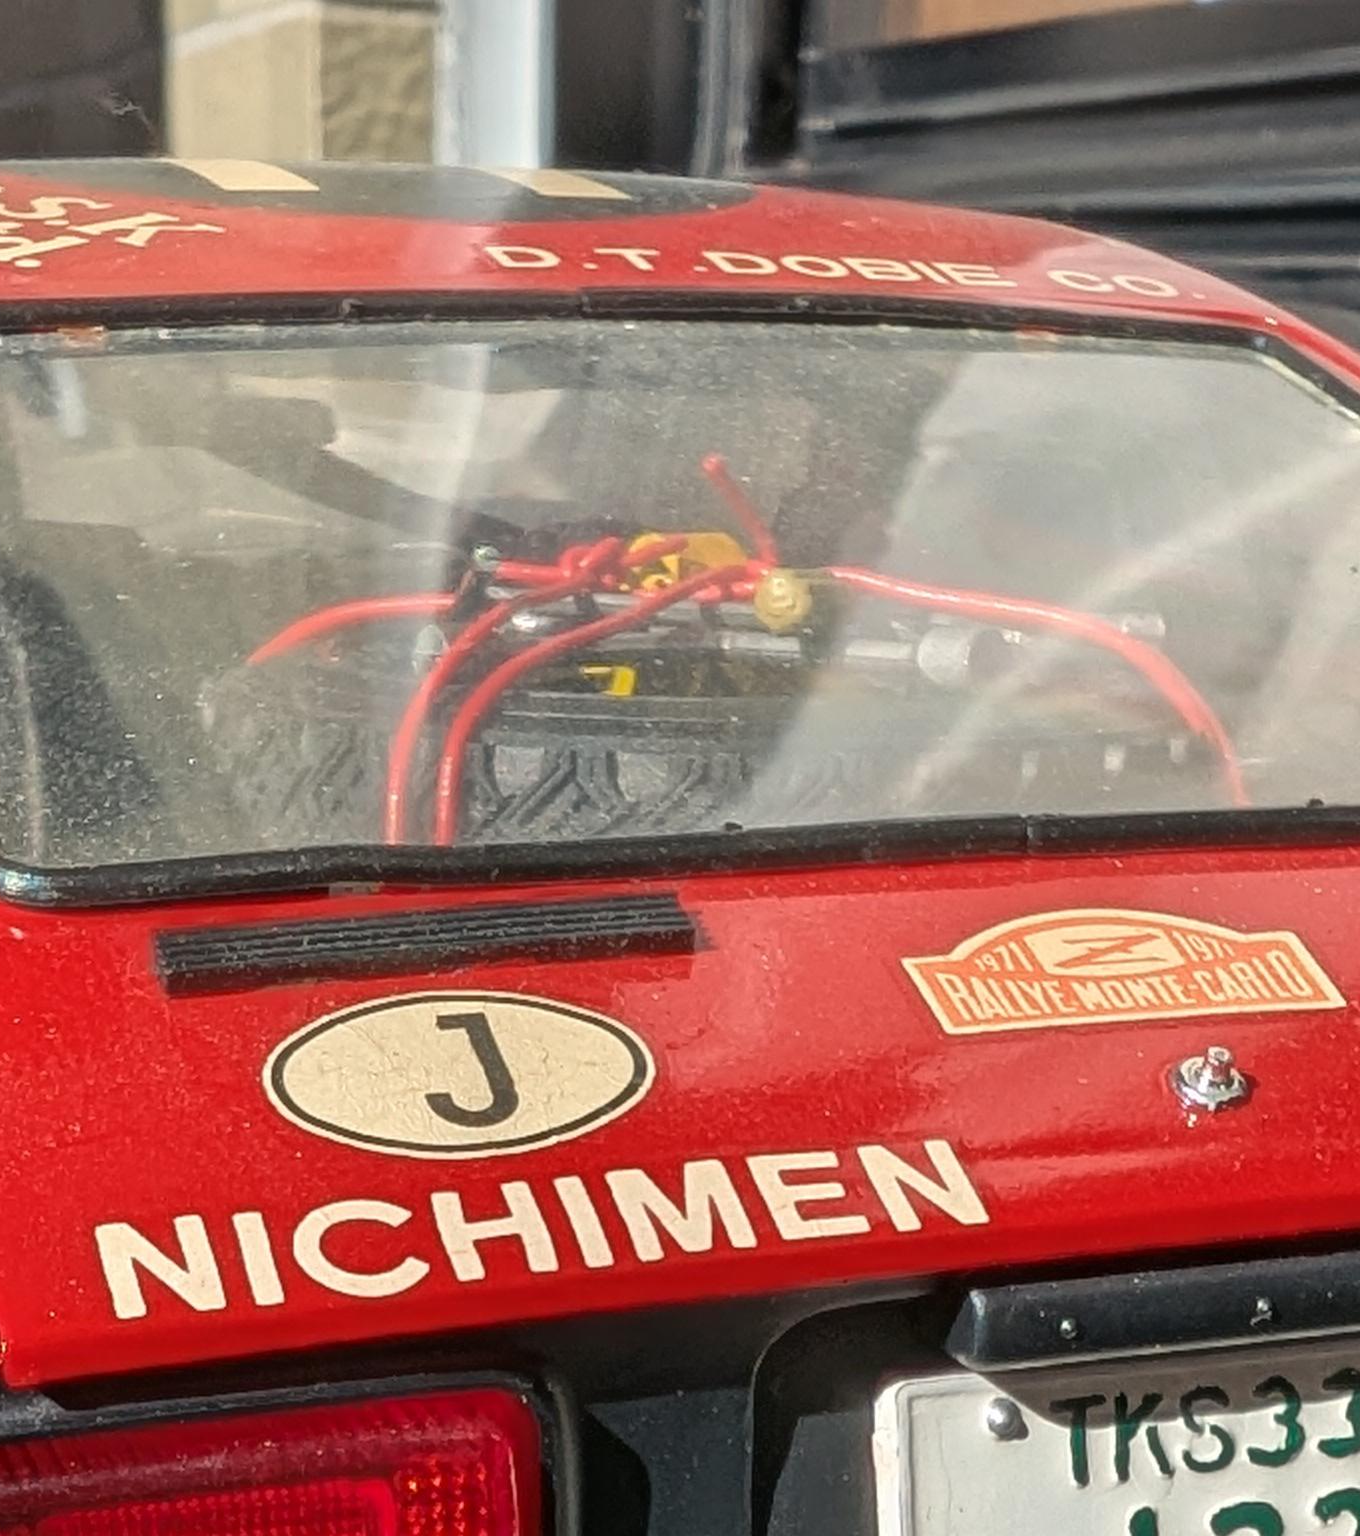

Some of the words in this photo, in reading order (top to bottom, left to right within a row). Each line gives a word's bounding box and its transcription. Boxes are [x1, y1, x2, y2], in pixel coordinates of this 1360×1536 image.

[975, 940, 1035, 974] 1971
[1177, 930, 1234, 962] 1971
[424, 1011, 519, 1128] J
[93, 1138, 991, 1321] NICHIMEN
